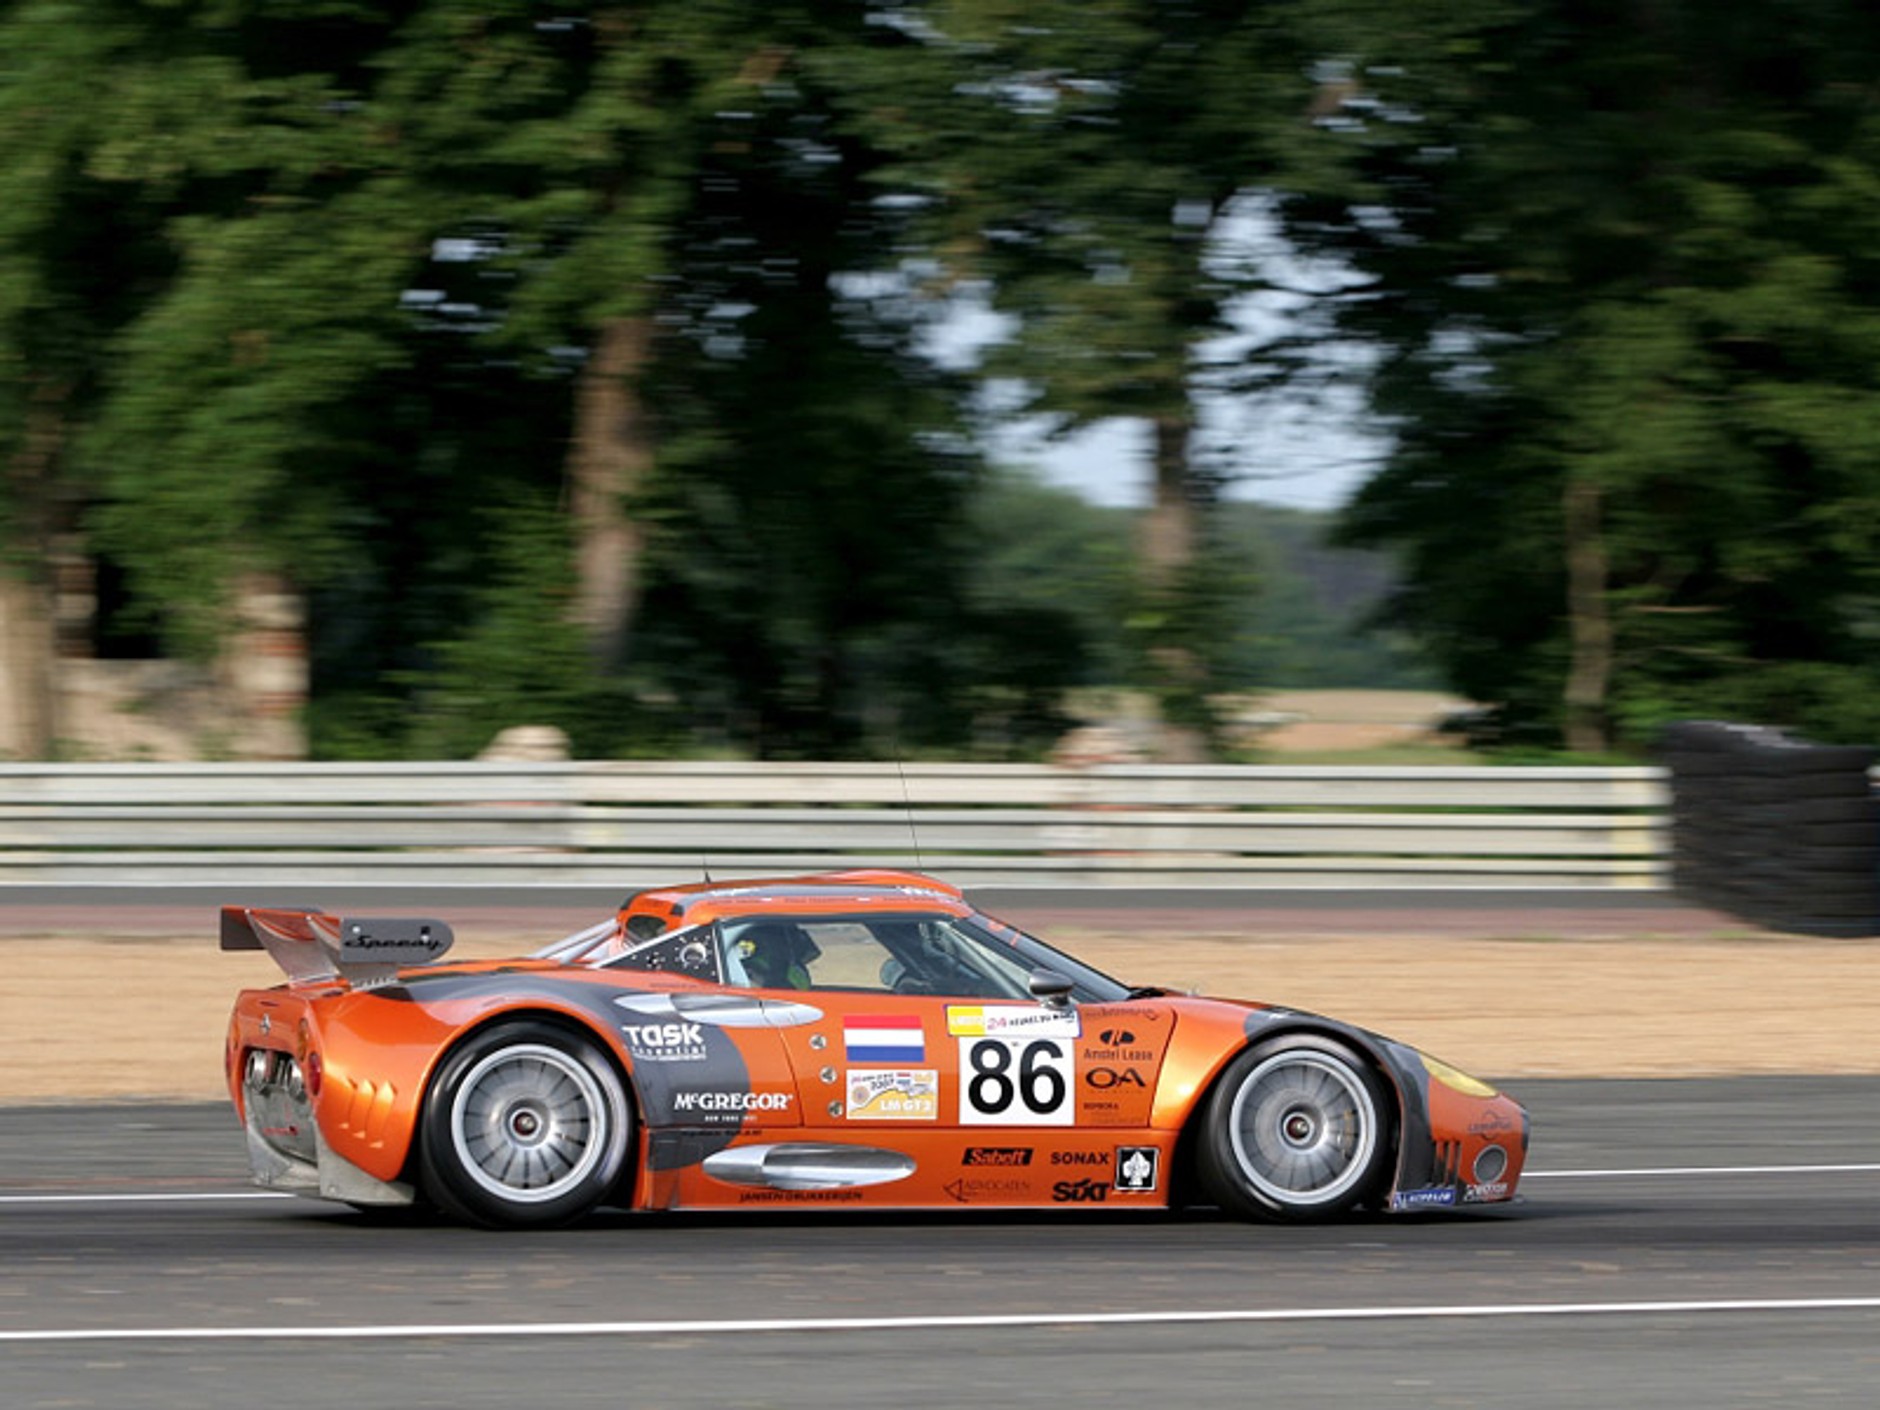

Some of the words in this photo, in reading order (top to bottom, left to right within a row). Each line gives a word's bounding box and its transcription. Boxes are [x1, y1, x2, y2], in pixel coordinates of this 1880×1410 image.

[1122, 1049, 1153, 1061] Lease
[968, 1039, 1066, 1114] 86
[1051, 1152, 1109, 1165] SONAX
